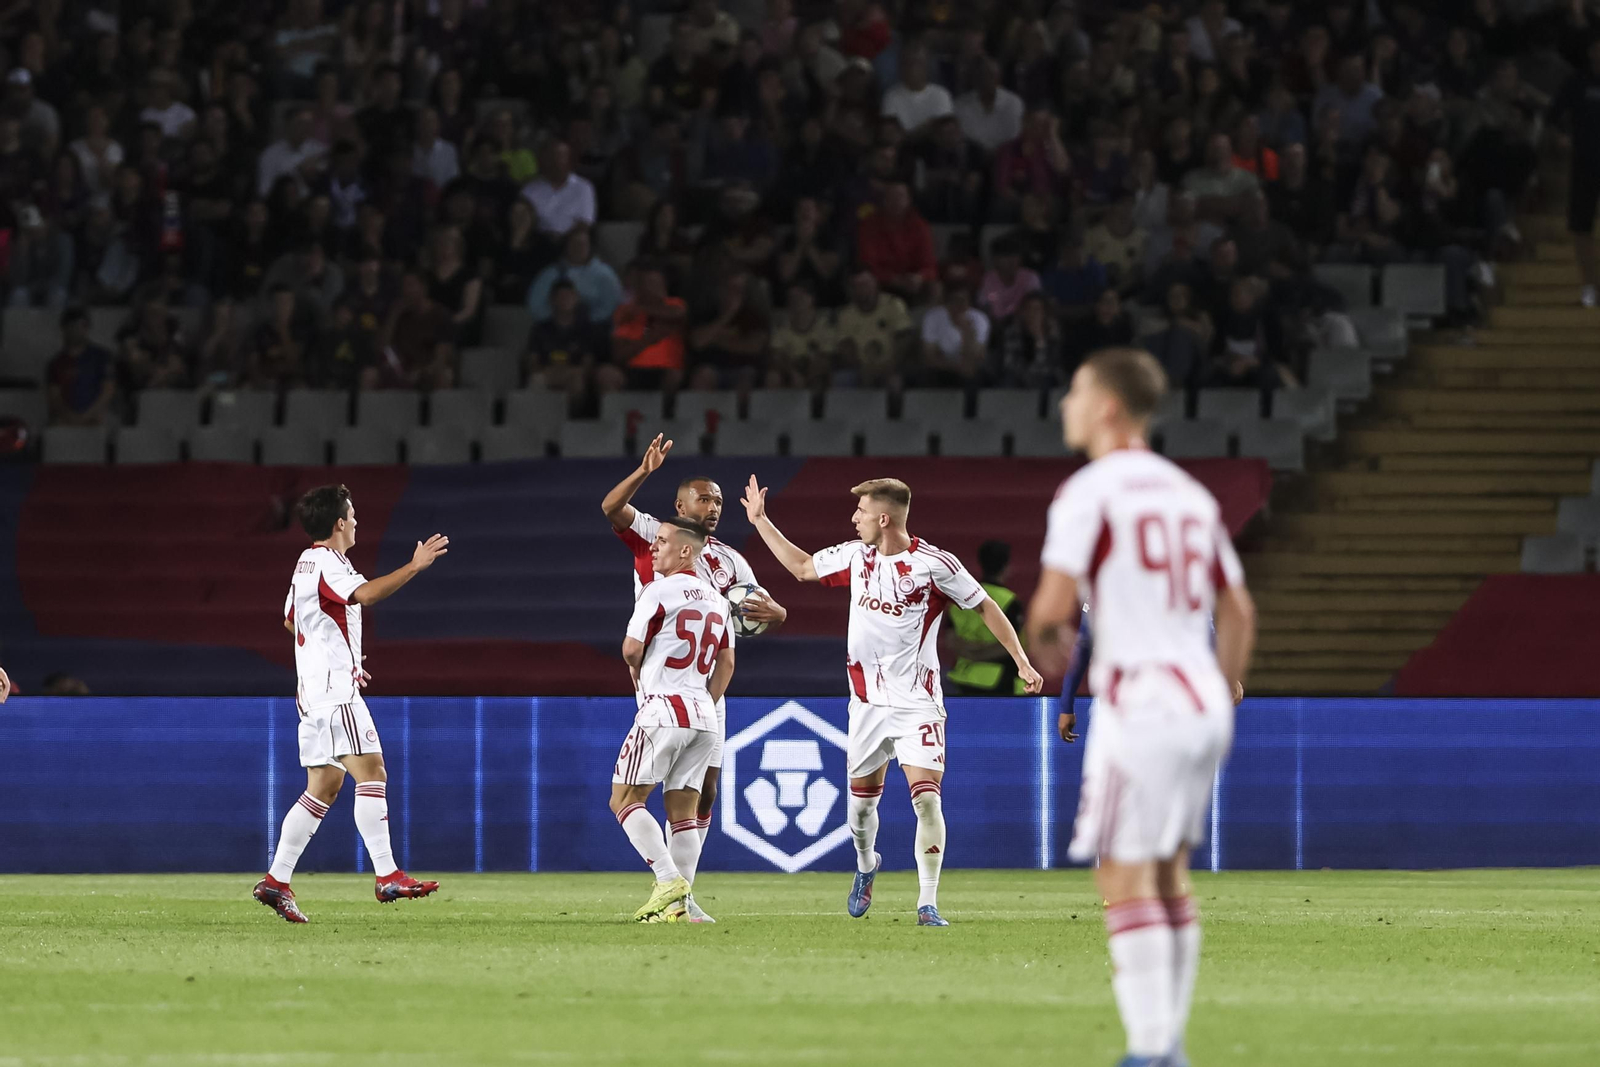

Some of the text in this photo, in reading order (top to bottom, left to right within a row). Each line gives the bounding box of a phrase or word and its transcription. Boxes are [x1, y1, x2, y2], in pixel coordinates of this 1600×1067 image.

[1135, 513, 1205, 612] 96
[665, 609, 724, 675] 56
[918, 722, 944, 748] 20
